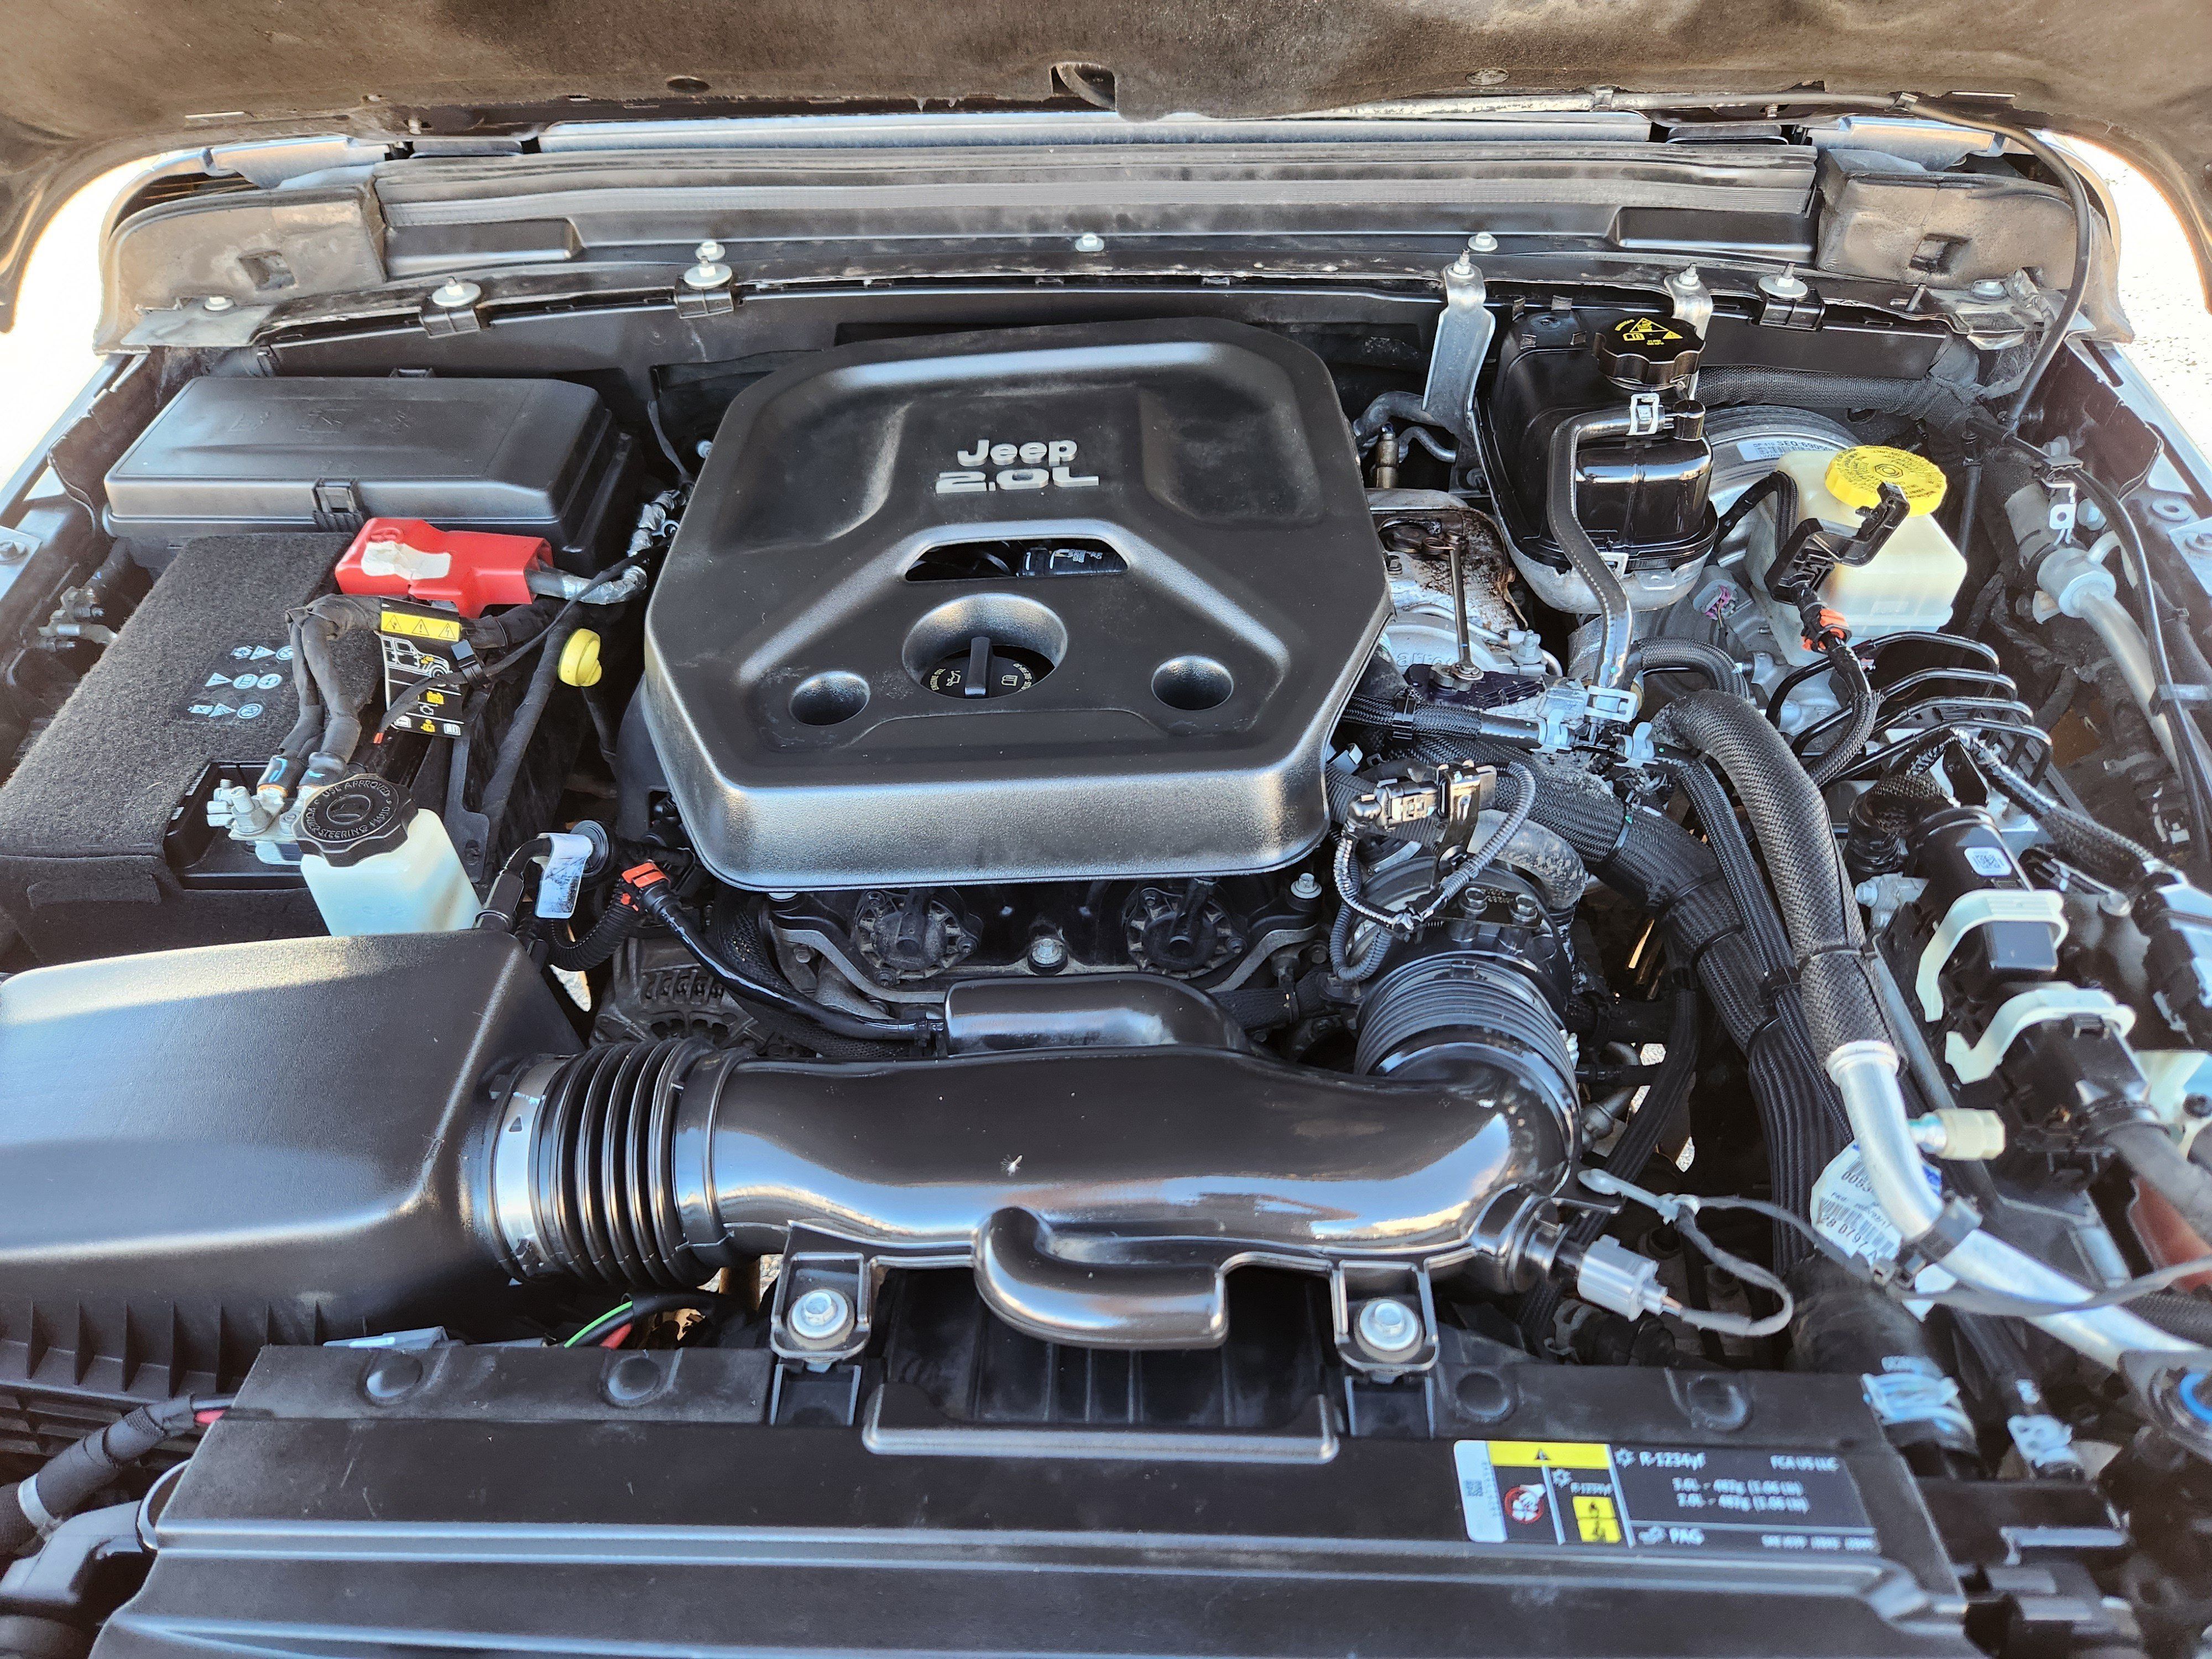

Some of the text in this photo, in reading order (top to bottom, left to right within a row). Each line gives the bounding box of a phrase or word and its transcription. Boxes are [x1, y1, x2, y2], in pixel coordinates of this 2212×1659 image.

[957, 440, 1077, 466] Jeep
[936, 467, 1099, 493] 2.0L
[930, 667, 946, 691] ENGINE OIL
[322, 780, 391, 797] USE APPROVED
[305, 806, 391, 839] POWER STEERING FLUID
[1640, 1451, 1705, 1470] R-1234yf
[1670, 1527, 1705, 1546] PAG
